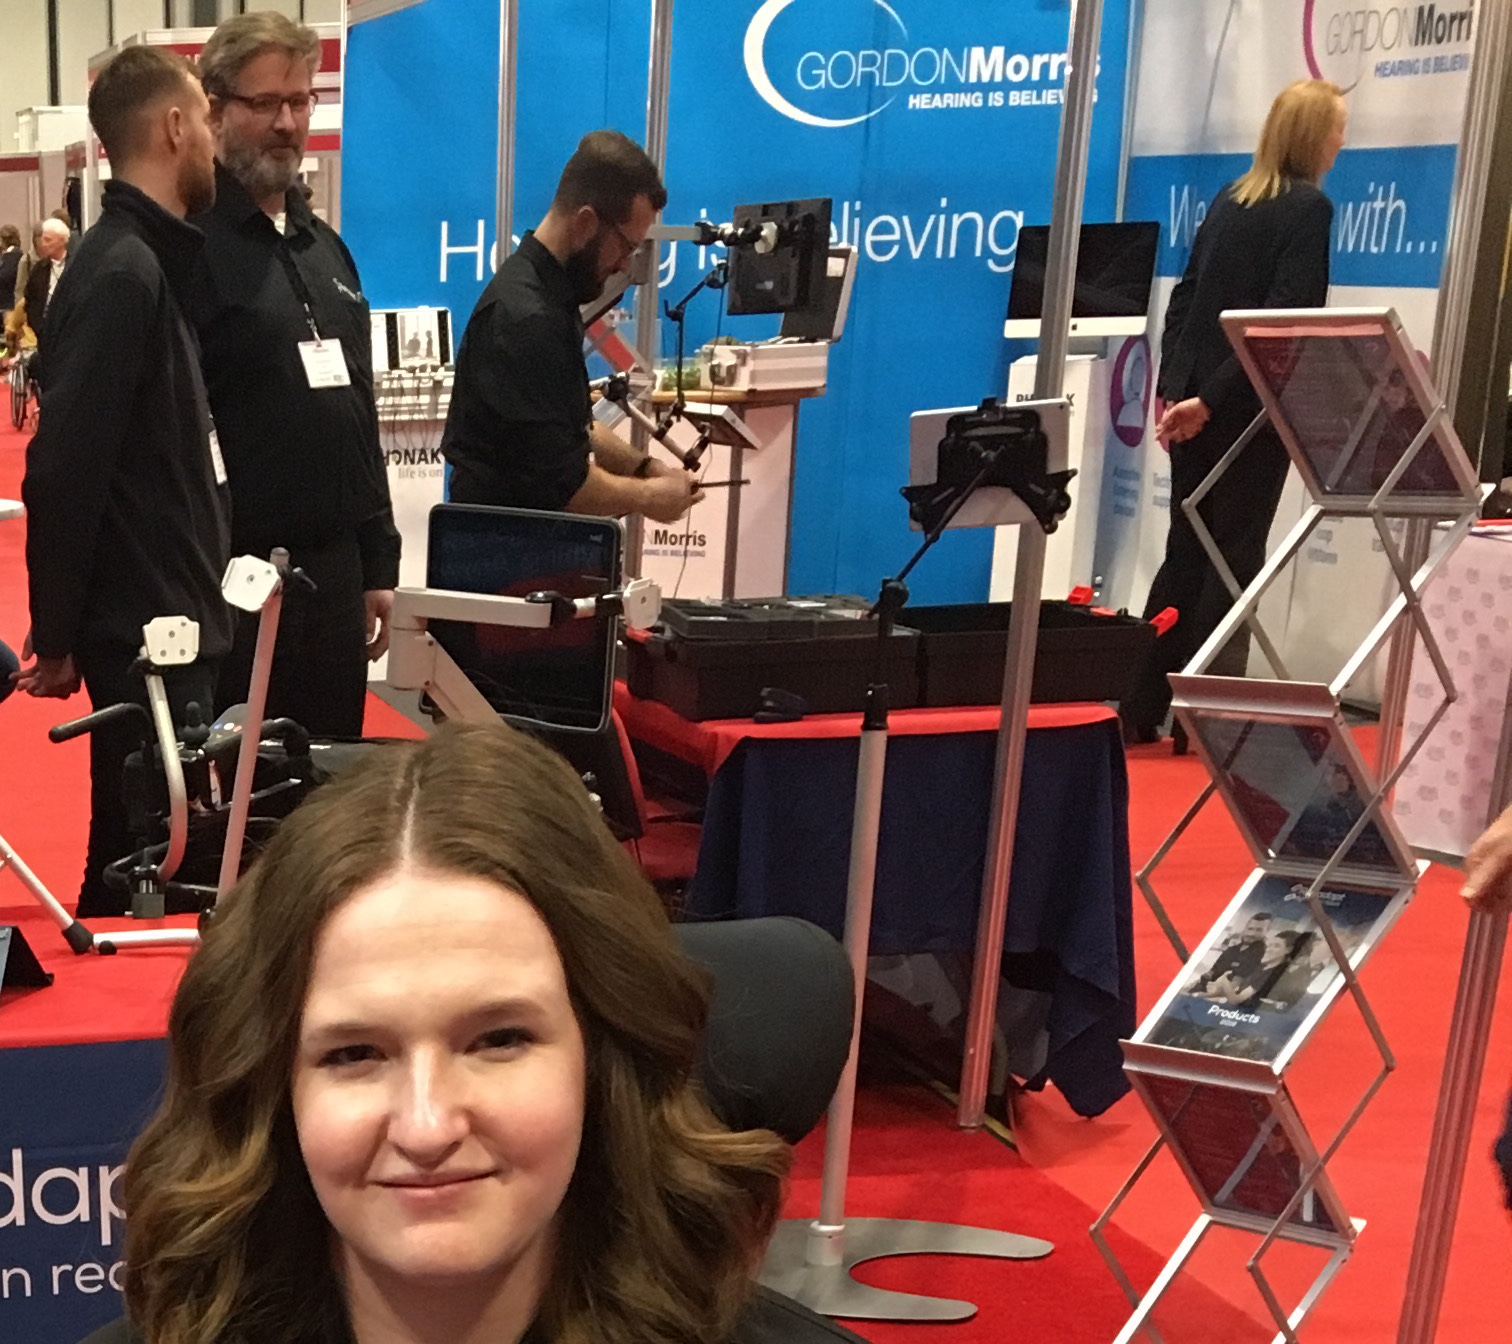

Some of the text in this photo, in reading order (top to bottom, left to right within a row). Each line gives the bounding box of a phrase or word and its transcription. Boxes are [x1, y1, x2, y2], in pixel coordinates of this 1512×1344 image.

[1374, 57, 1419, 77] HEARING
[908, 91, 983, 109] HEARING
[988, 90, 1004, 107] IS
[1337, 181, 1438, 254] with...
[398, 467, 416, 479] life
[1208, 1004, 1260, 1024] Products
